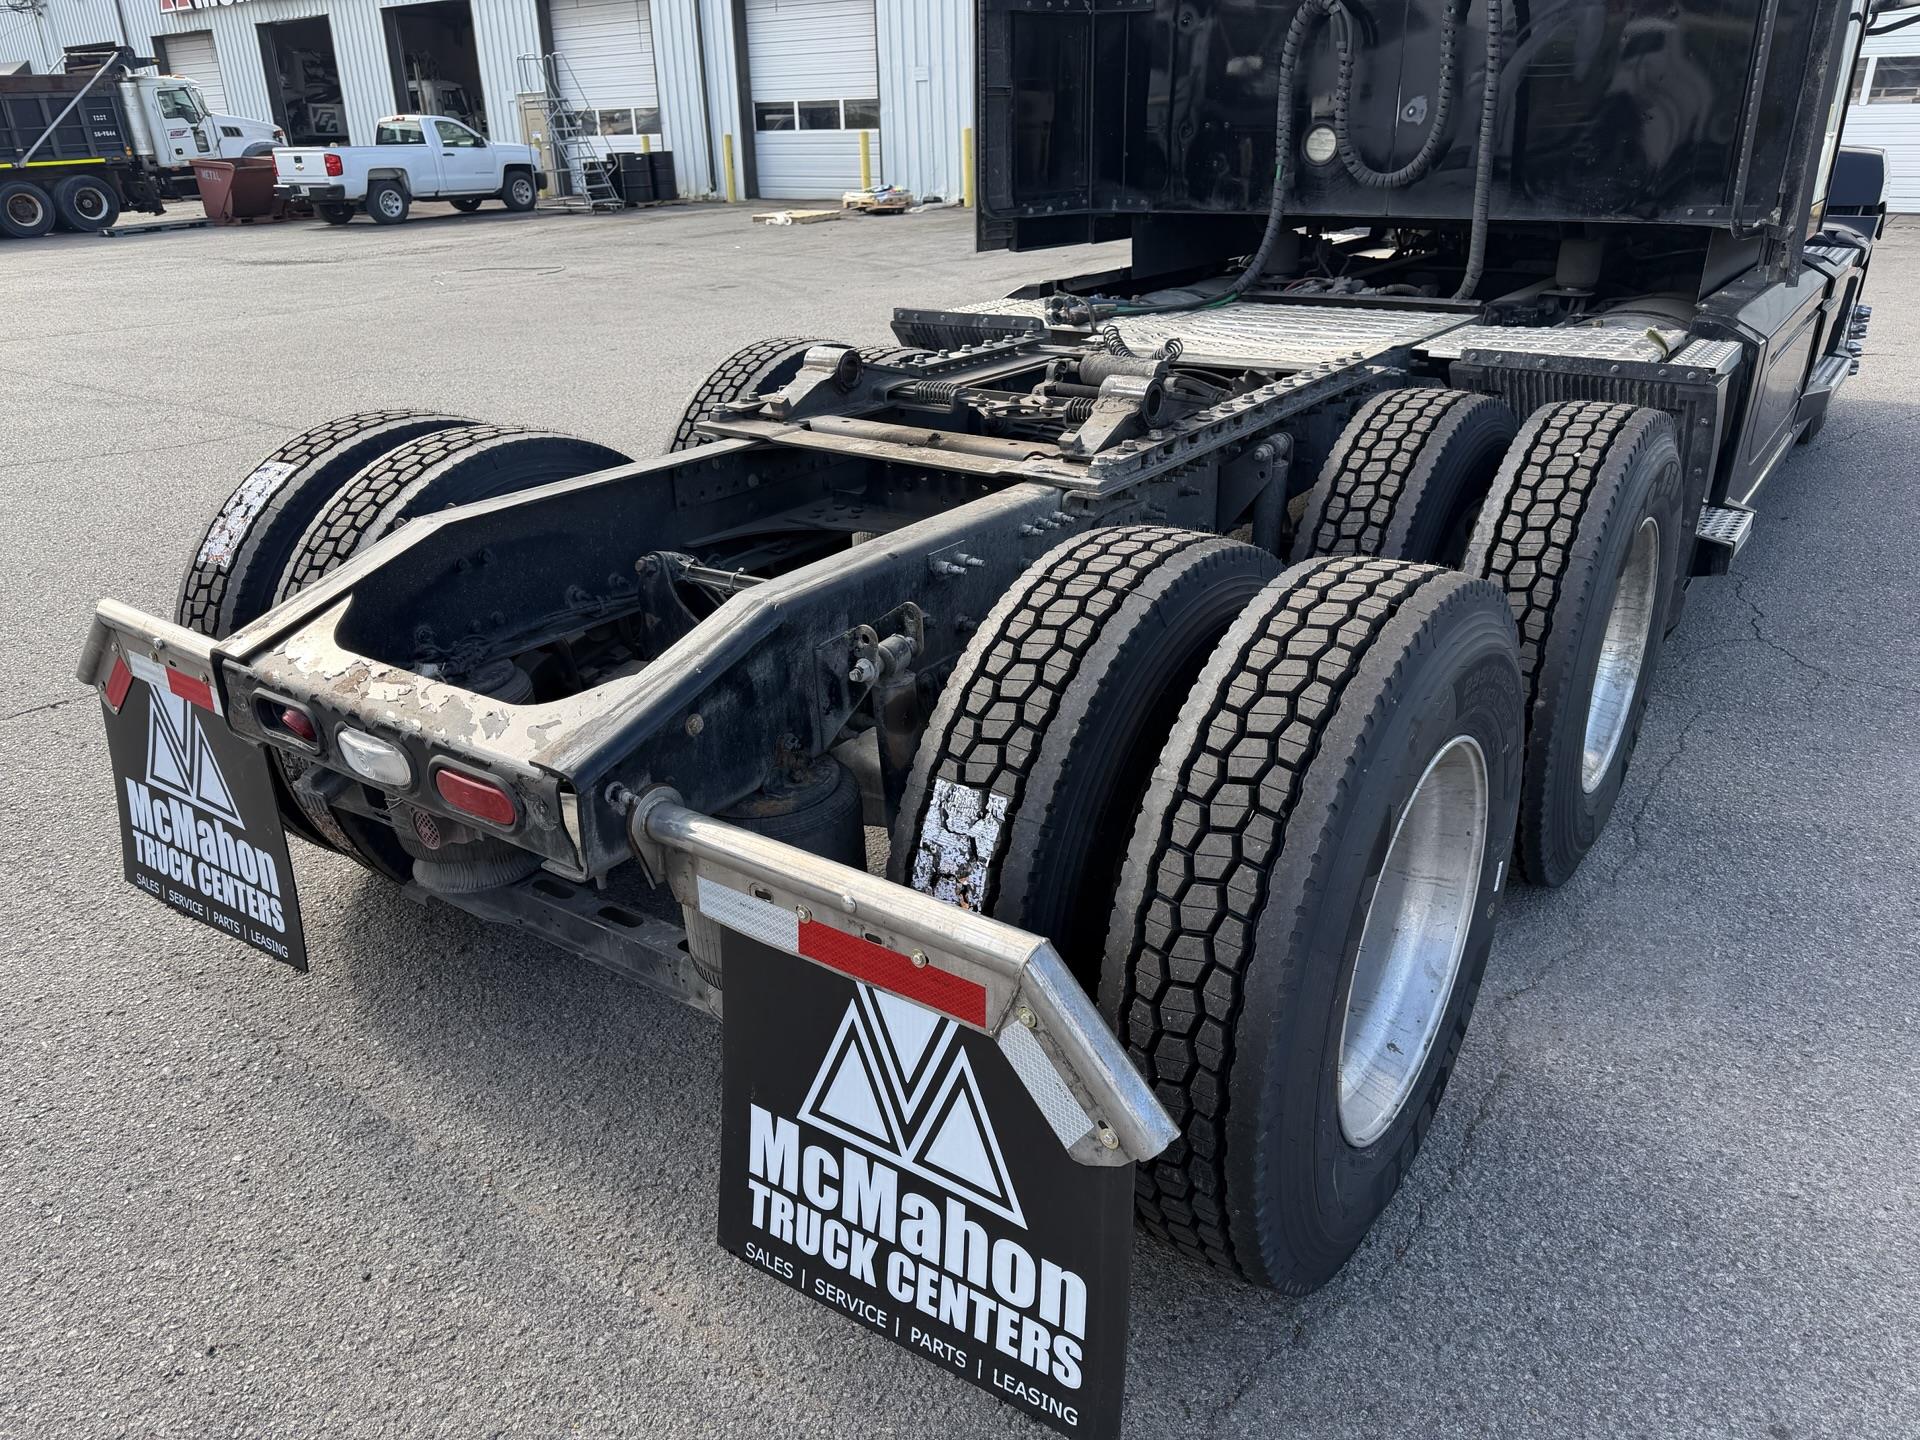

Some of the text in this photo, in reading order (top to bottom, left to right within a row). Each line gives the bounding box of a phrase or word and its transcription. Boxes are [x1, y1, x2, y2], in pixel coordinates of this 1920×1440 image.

[125, 776, 281, 897] McMahon
[132, 830, 286, 933] TRUCK CENTERS
[136, 872, 160, 894] SALES
[169, 890, 203, 917] SERVICE
[213, 911, 240, 933] PARTS
[250, 928, 289, 959] LEASING
[748, 1103, 1087, 1340] McMahon
[748, 1178, 1083, 1389] TRUCK CENTERS
[745, 1241, 794, 1279] SALES
[815, 1278, 888, 1329] SERVICE
[911, 1326, 967, 1368] PARTS
[993, 1368, 1079, 1426] LEASING
